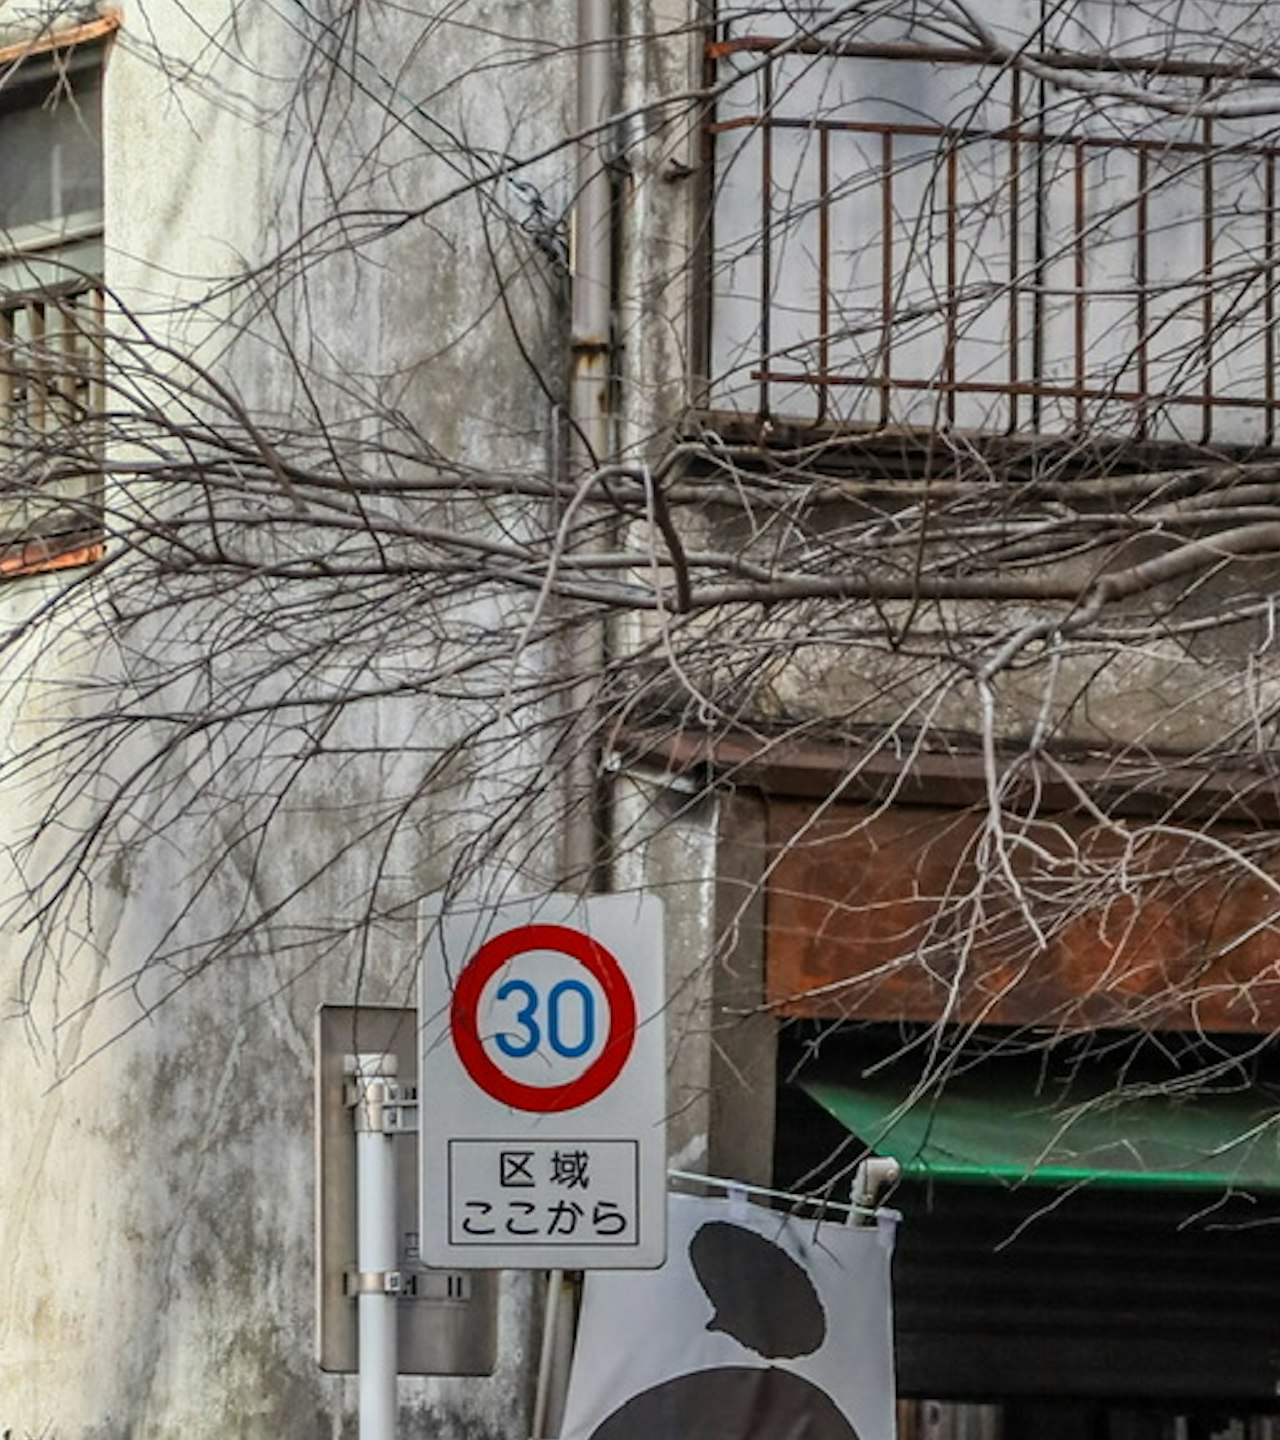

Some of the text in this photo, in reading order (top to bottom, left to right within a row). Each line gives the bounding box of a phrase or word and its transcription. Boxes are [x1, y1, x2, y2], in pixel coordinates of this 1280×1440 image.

[493, 978, 595, 1060] 30
[499, 1150, 590, 1189] 区域
[461, 1199, 627, 1237] ここから
